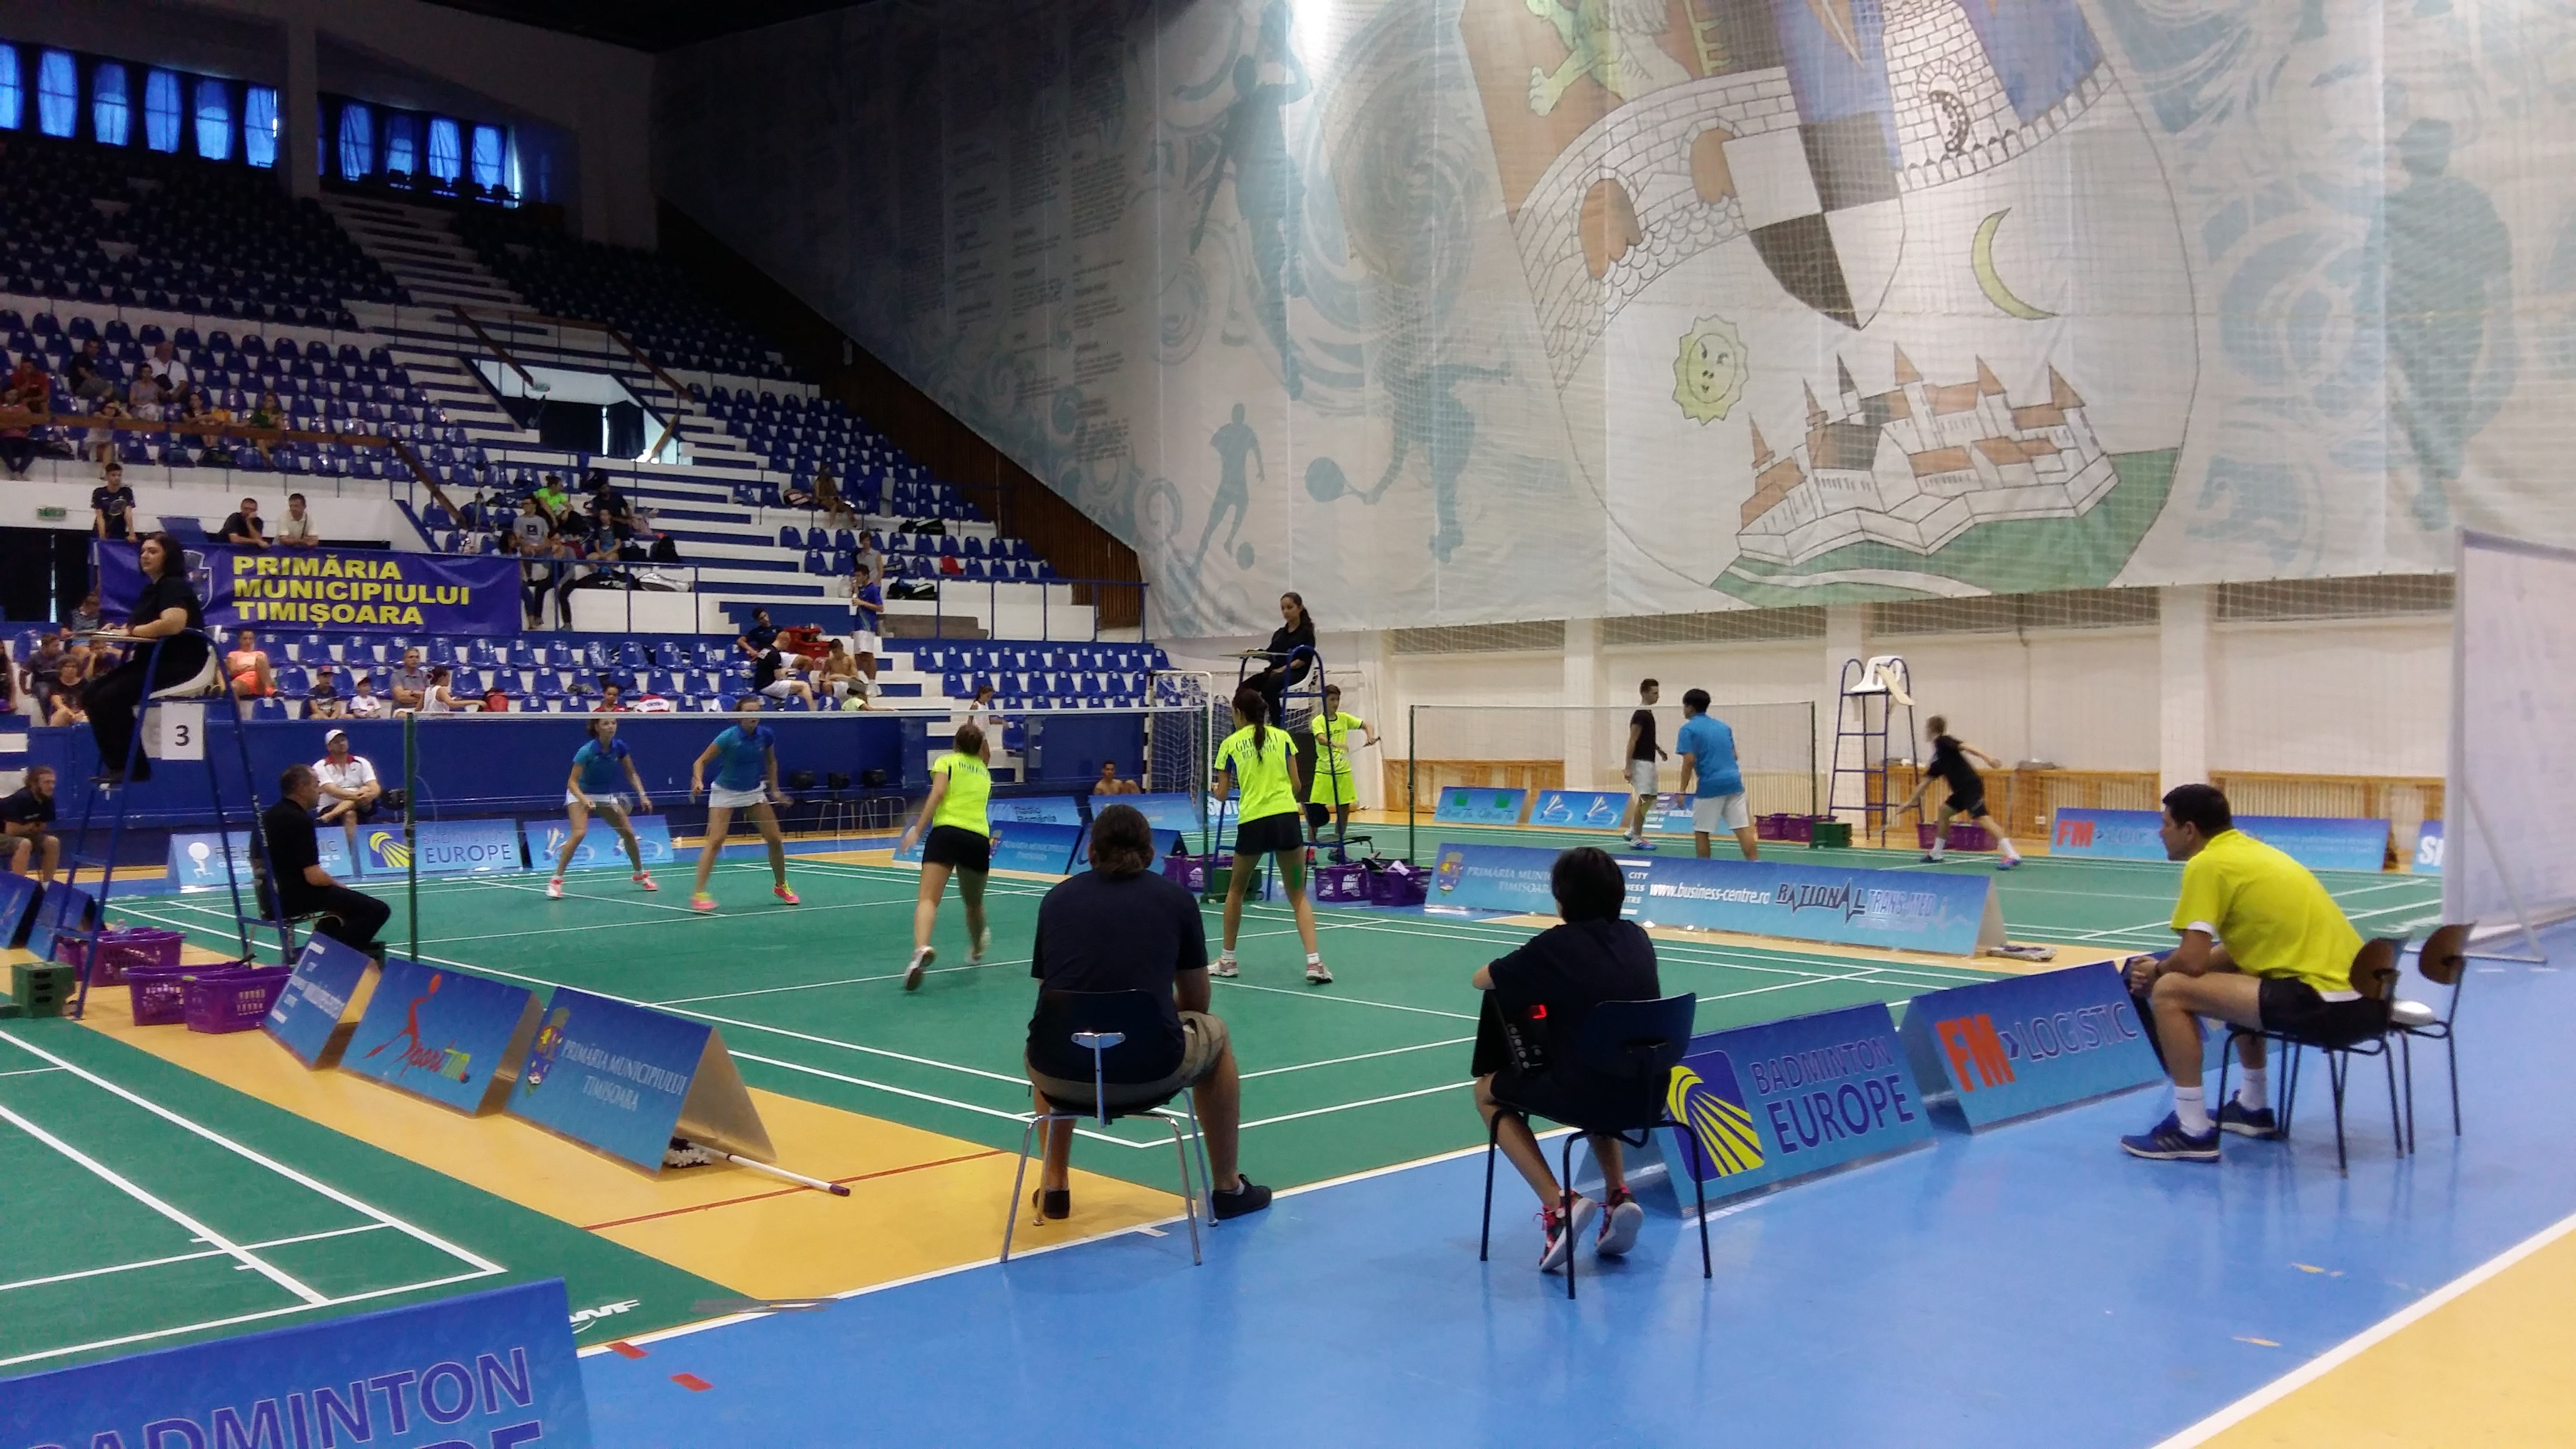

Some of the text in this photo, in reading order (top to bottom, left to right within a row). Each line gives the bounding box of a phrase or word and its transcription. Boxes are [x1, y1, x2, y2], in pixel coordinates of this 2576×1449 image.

[232, 554, 402, 580] PRIMĂRIA
[233, 578, 470, 605] MUNICIPIULUI
[232, 601, 424, 629] TIMIȘOARA
[175, 724, 190, 746] 3
[2056, 819, 2094, 848] FM
[425, 844, 512, 864] EUROPE
[1628, 871, 1649, 880] CITY
[1649, 882, 1771, 904] www.business-centre.ro
[1775, 877, 1867, 925] RATIONAL
[1937, 1002, 2139, 1093] FM LOGISTIC
[607, 1055, 688, 1095] MUNICIPIULUI
[1750, 1037, 1895, 1096] BADMINTON
[1766, 1073, 1916, 1155] EUROPE
[26, 1347, 533, 1449] DMINTON
